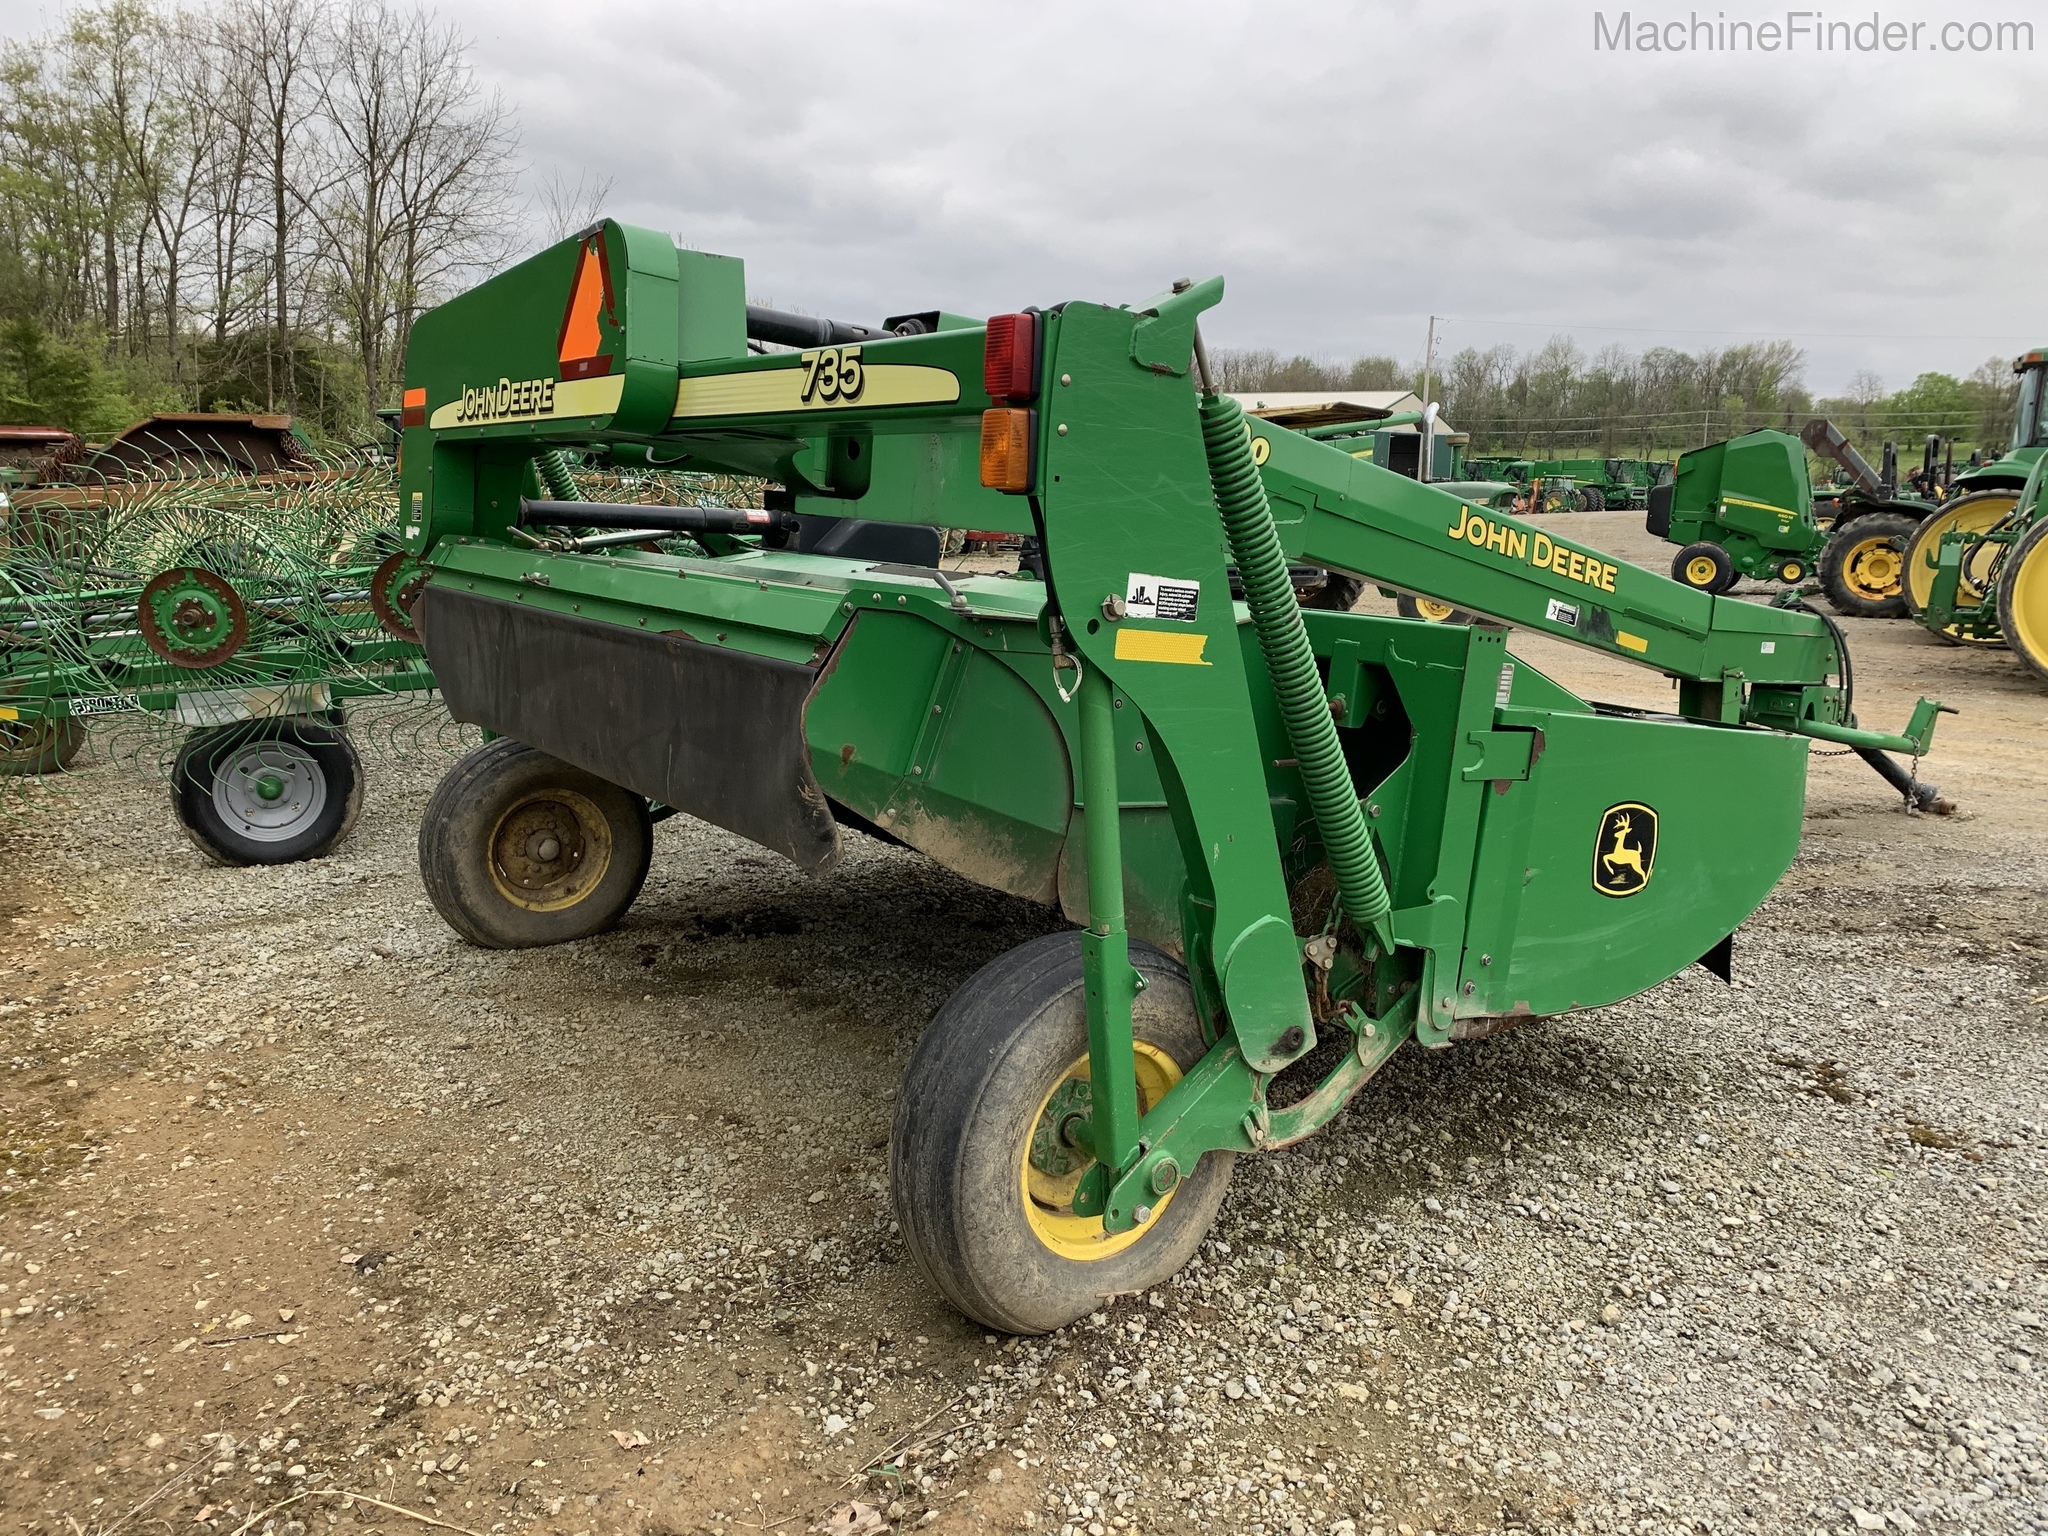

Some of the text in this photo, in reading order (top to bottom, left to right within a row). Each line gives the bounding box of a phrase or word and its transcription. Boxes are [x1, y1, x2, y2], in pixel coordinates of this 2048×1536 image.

[457, 377, 554, 421] JOHN DEERE
[801, 346, 865, 405] 735
[1448, 503, 1618, 594] JOHN DEERE
